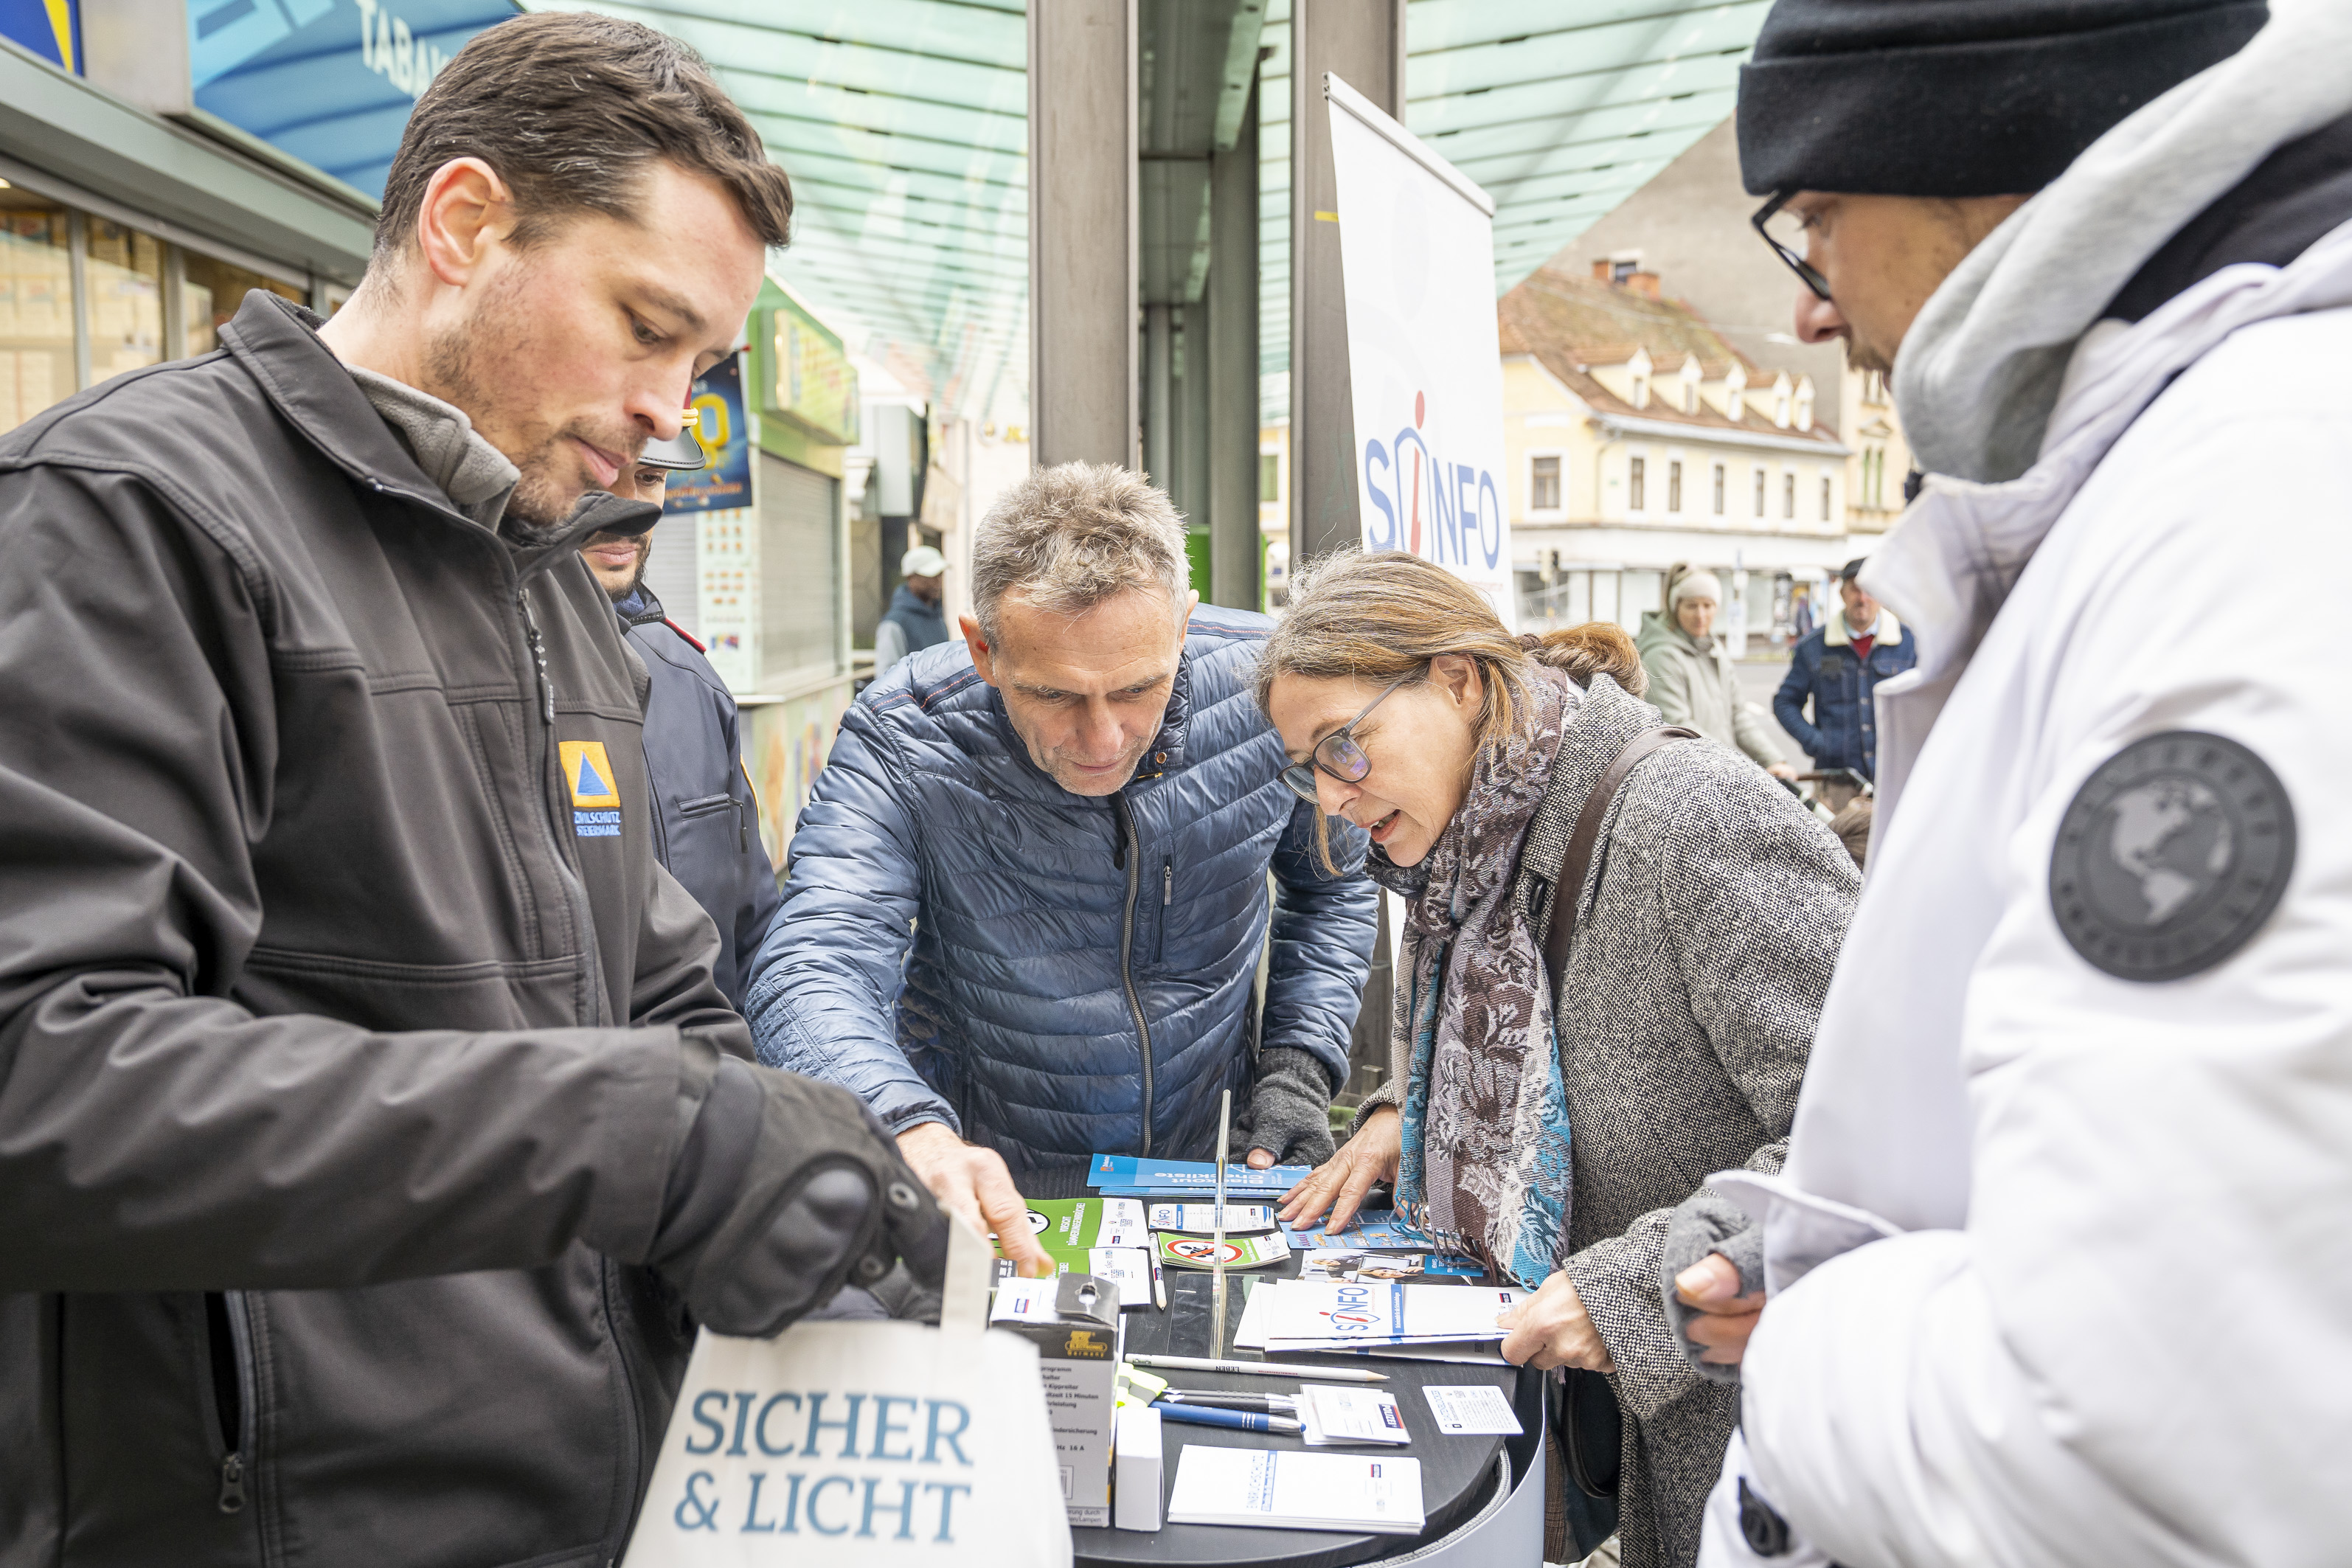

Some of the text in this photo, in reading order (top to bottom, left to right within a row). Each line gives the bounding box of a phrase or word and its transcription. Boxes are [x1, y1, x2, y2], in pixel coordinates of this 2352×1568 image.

[573, 811, 621, 824] ZIVILSCHUTZ
[576, 824, 621, 837] STEIERMARK
[1381, 1404, 1398, 1426] POLIZEI
[684, 1390, 974, 1467] SICHER
[674, 1471, 971, 1544] & LICHT
